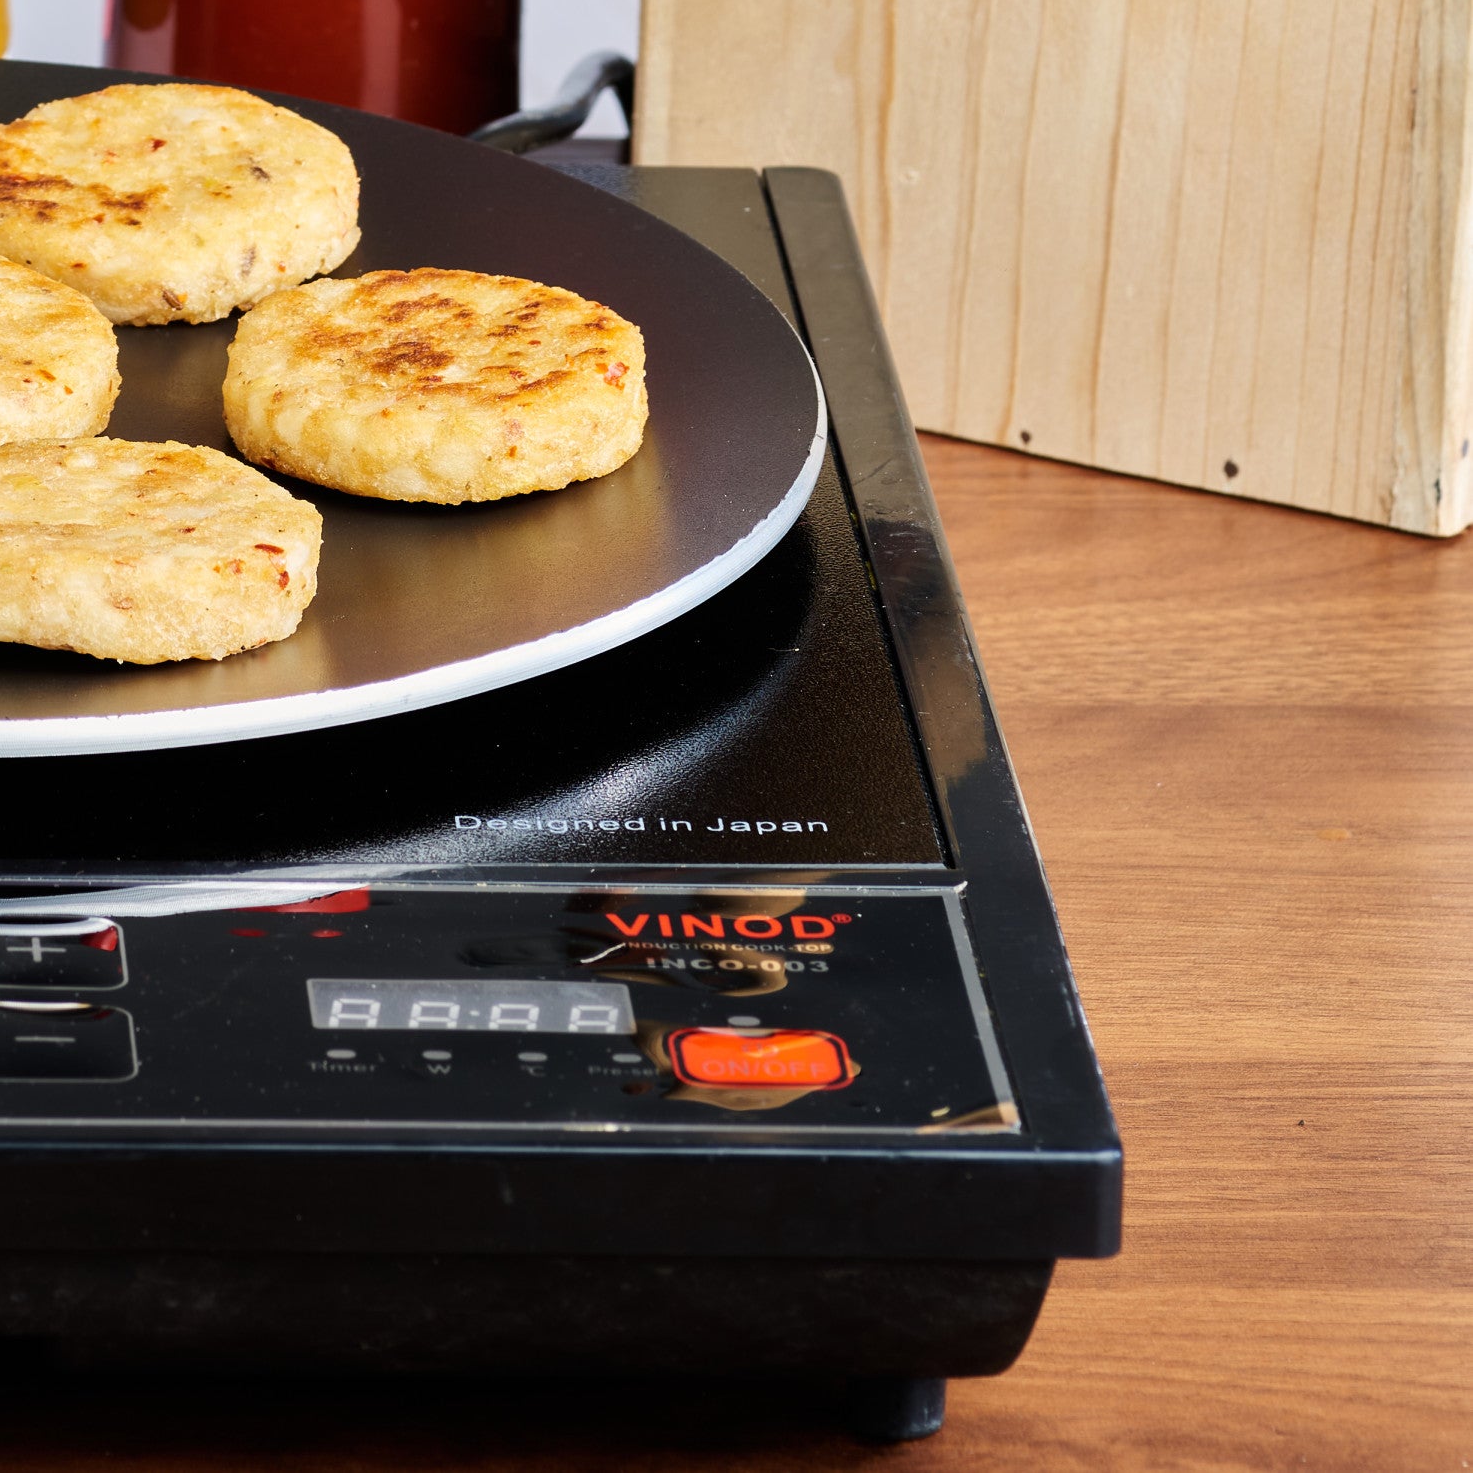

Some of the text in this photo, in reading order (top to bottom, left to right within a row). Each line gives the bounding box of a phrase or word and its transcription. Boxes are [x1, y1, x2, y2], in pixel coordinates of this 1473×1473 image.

[454, 815, 829, 835] Designed in Japan
[645, 957, 830, 973] INCO-003
[427, 1063, 451, 1075] W
[701, 1059, 826, 1078] ON/OFF
